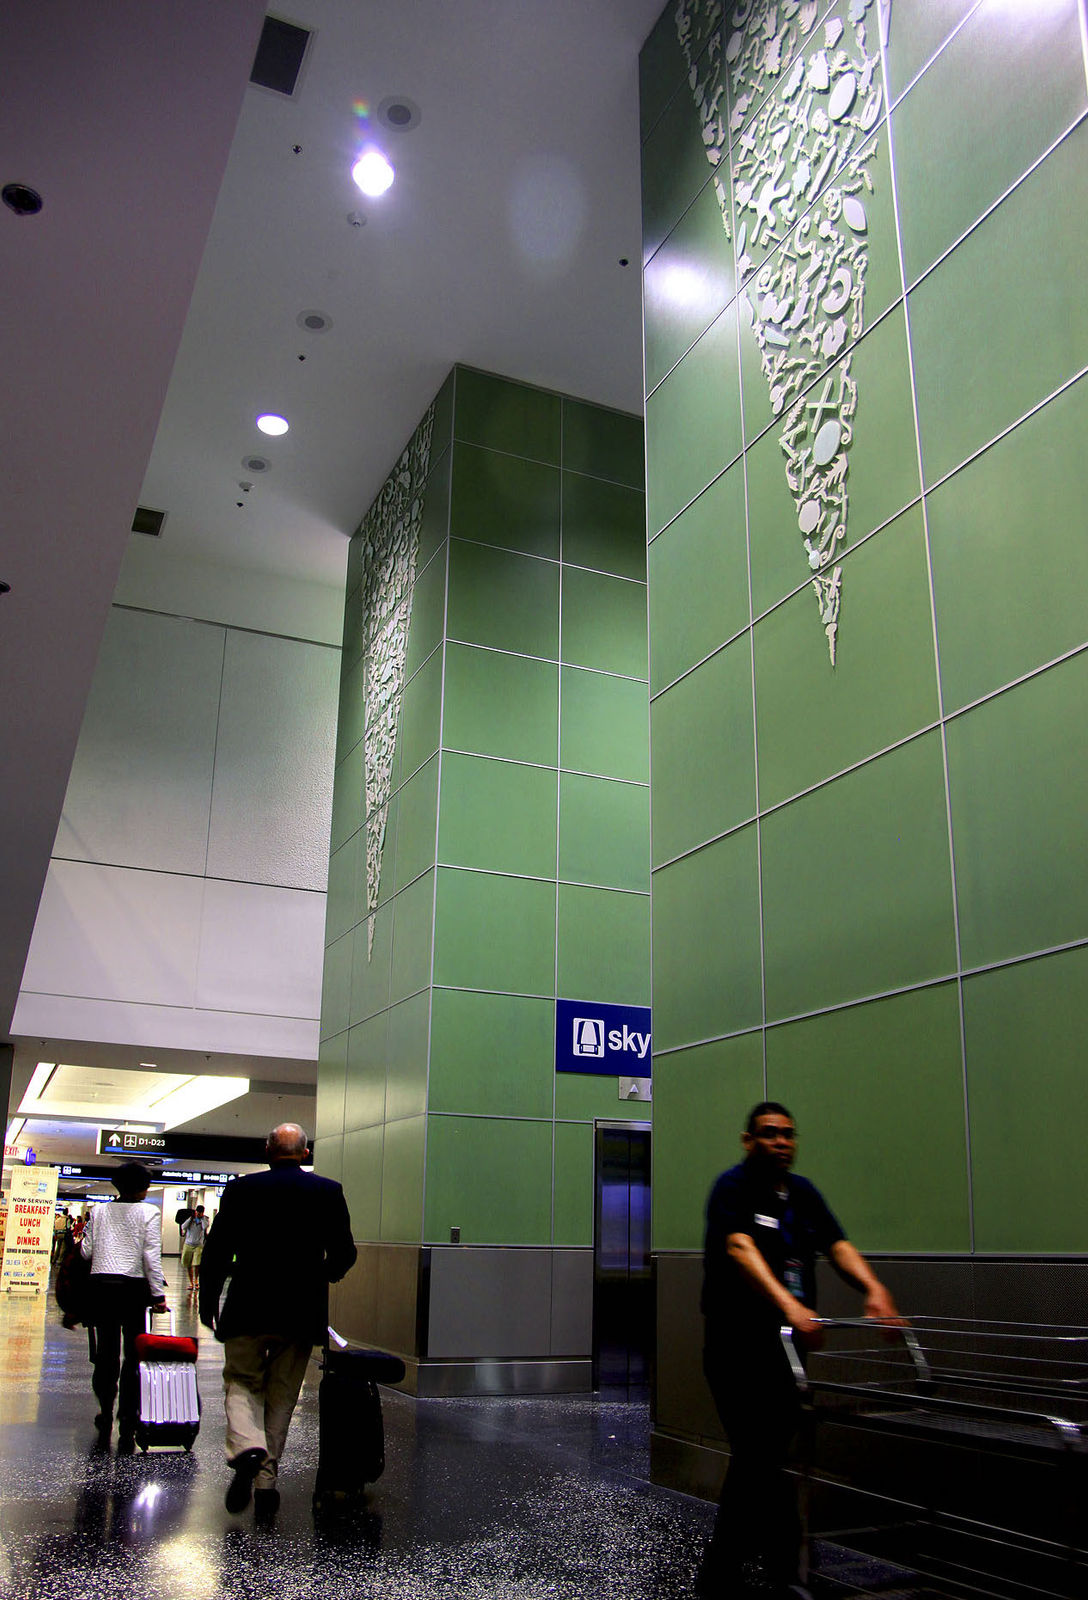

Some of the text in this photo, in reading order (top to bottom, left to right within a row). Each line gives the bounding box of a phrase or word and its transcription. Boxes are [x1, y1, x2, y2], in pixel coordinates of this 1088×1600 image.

[608, 1024, 651, 1058] sky
[138, 1137, 166, 1147] D1-D23
[4, 1145, 18, 1156] EXIT
[14, 1204, 50, 1215] BREAKFAST
[19, 1217, 41, 1227] LUNCH
[16, 1236, 40, 1246] DINNER
